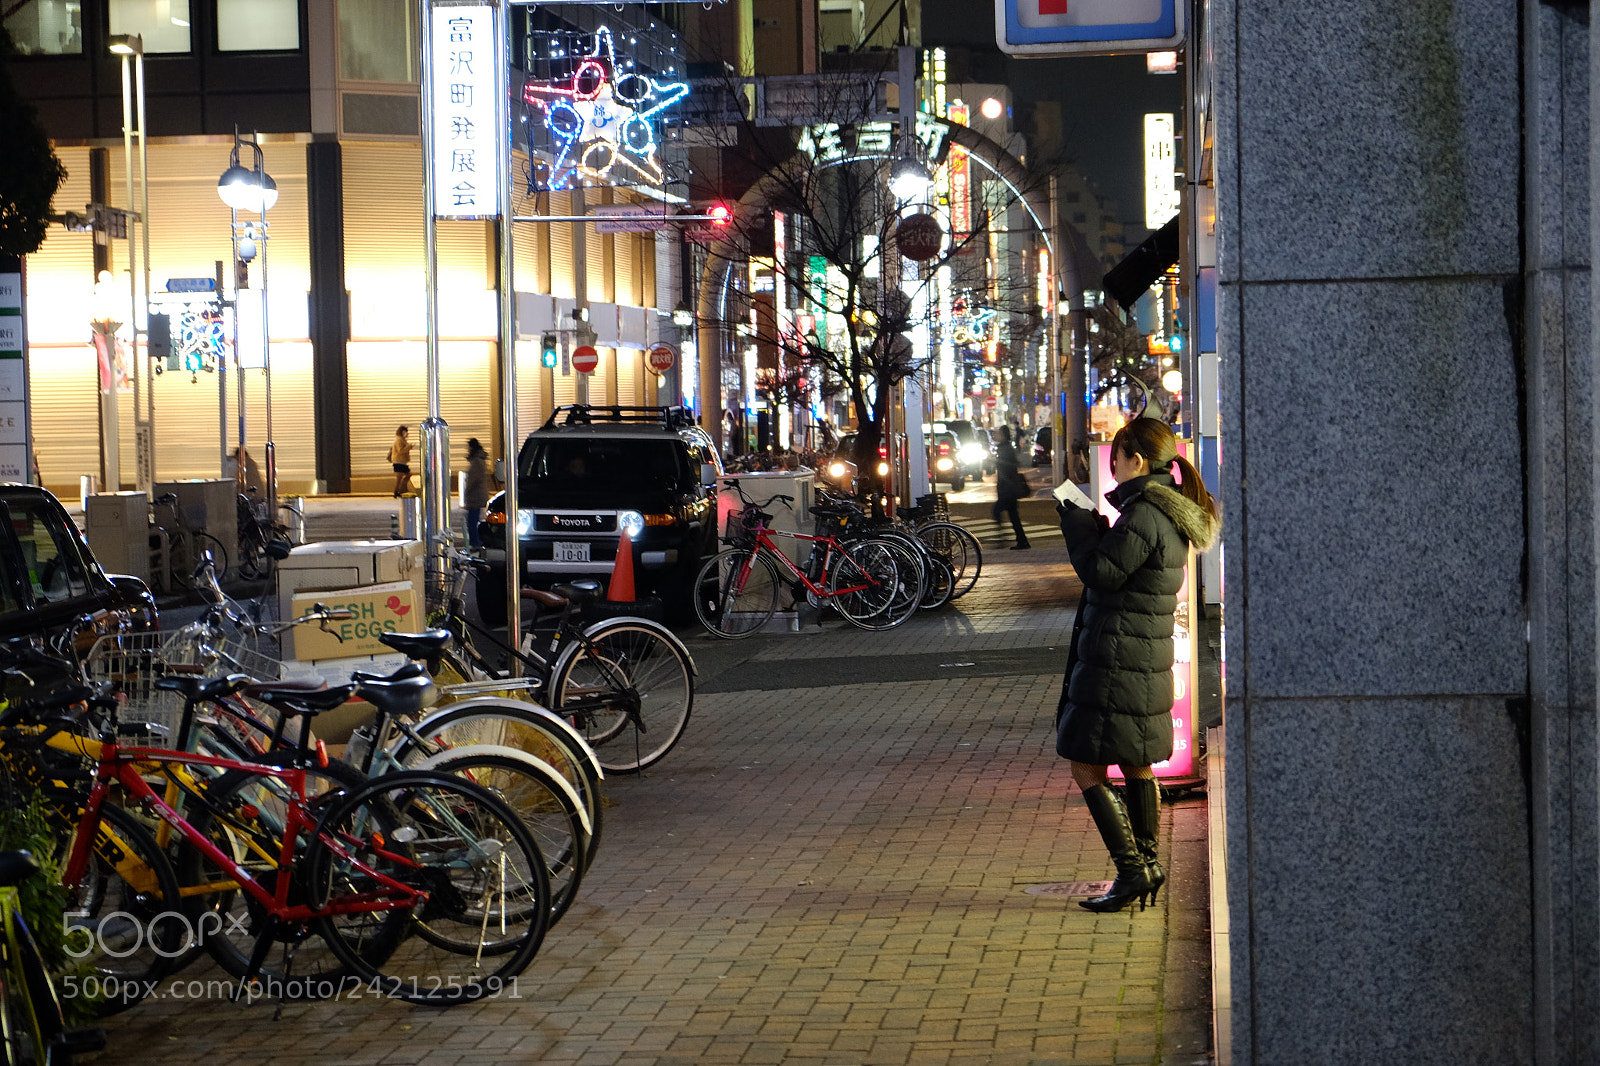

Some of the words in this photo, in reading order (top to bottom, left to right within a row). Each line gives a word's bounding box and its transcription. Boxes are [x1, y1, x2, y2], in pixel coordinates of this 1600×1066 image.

[448, 16, 476, 206] 富沢町発展会
[900, 228, 940, 247] 消火栓
[560, 519, 591, 527] TOYOTA
[562, 549, 588, 561] 10-01
[341, 620, 397, 641] EGGS
